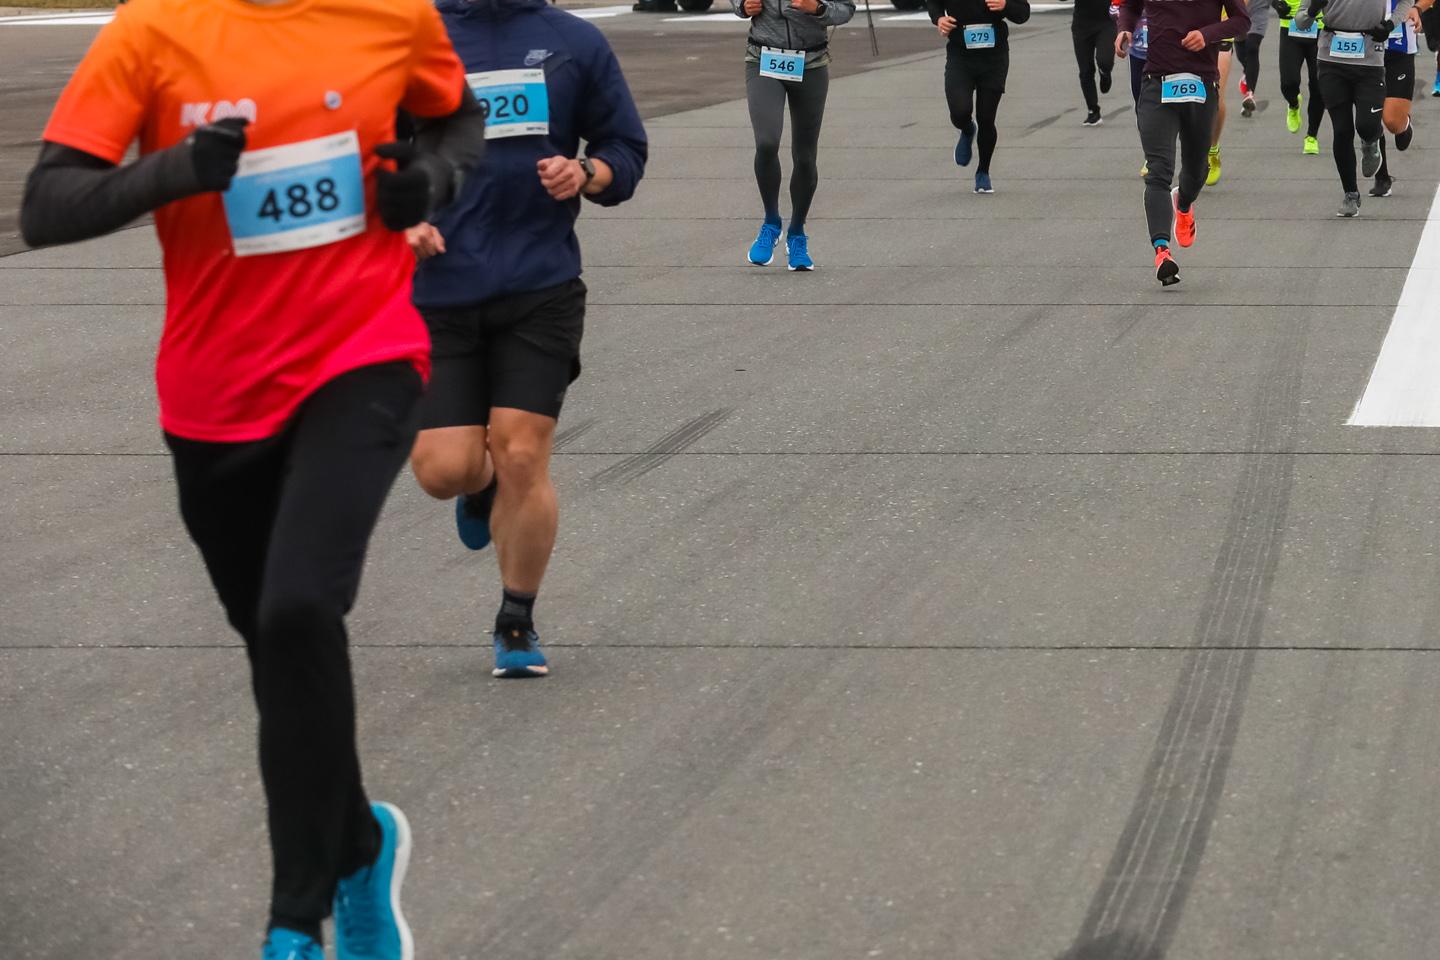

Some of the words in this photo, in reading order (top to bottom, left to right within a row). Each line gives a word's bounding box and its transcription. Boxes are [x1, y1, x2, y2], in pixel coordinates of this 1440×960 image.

[970, 32, 989, 42] 279
[1337, 41, 1357, 51] 155
[769, 59, 795, 72] 546
[1171, 83, 1197, 96] 769
[257, 177, 339, 222] 488
